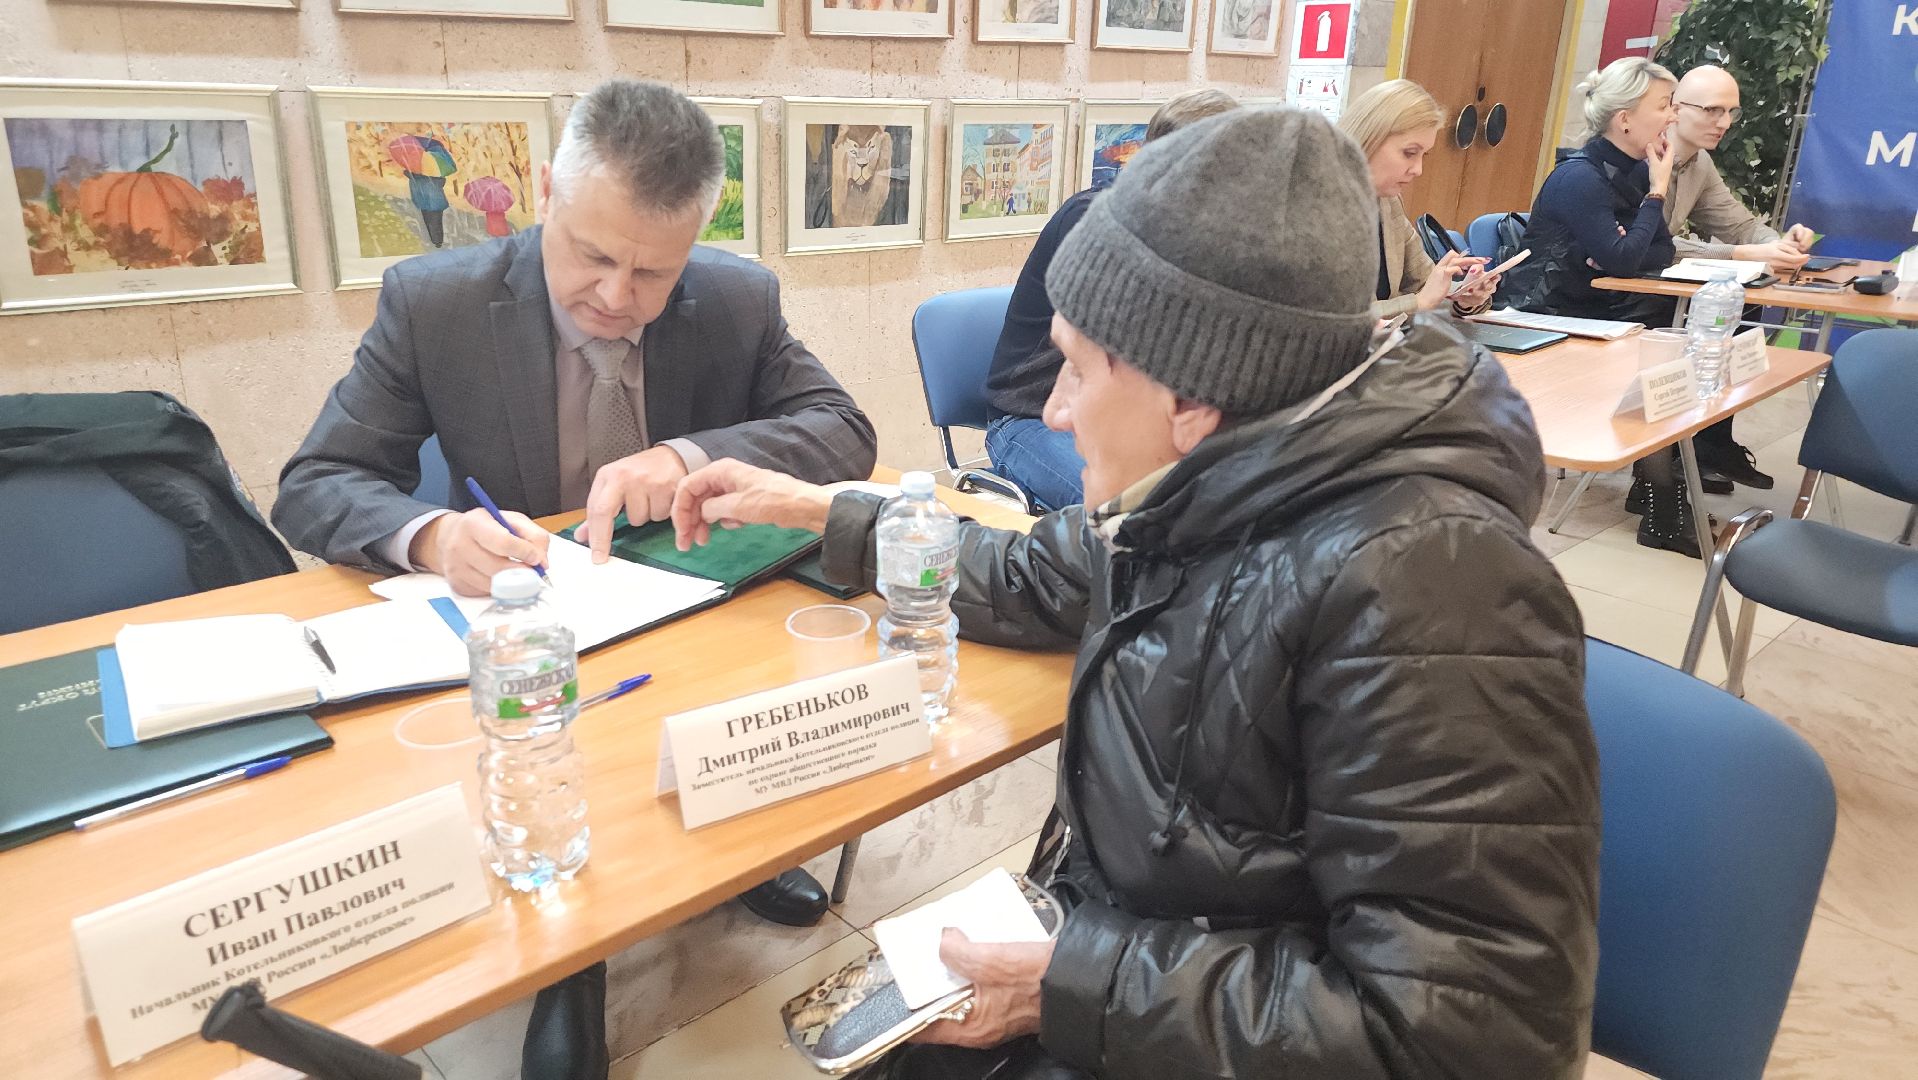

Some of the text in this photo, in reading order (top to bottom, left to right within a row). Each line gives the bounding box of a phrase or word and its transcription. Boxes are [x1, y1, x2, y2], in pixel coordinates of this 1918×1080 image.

[697, 702, 911, 777] Дмитрий Владимирович
[726, 683, 869, 738] ГРЕБЕНЬКОВ
[793, 771, 820, 788] России
[183, 840, 403, 939] СЕРГУШКИН
[206, 877, 407, 967] Иван Павлович
[130, 976, 221, 1020] Начальник
[353, 905, 399, 930] отдела
[401, 880, 456, 912] полиции
[266, 957, 317, 985] России
